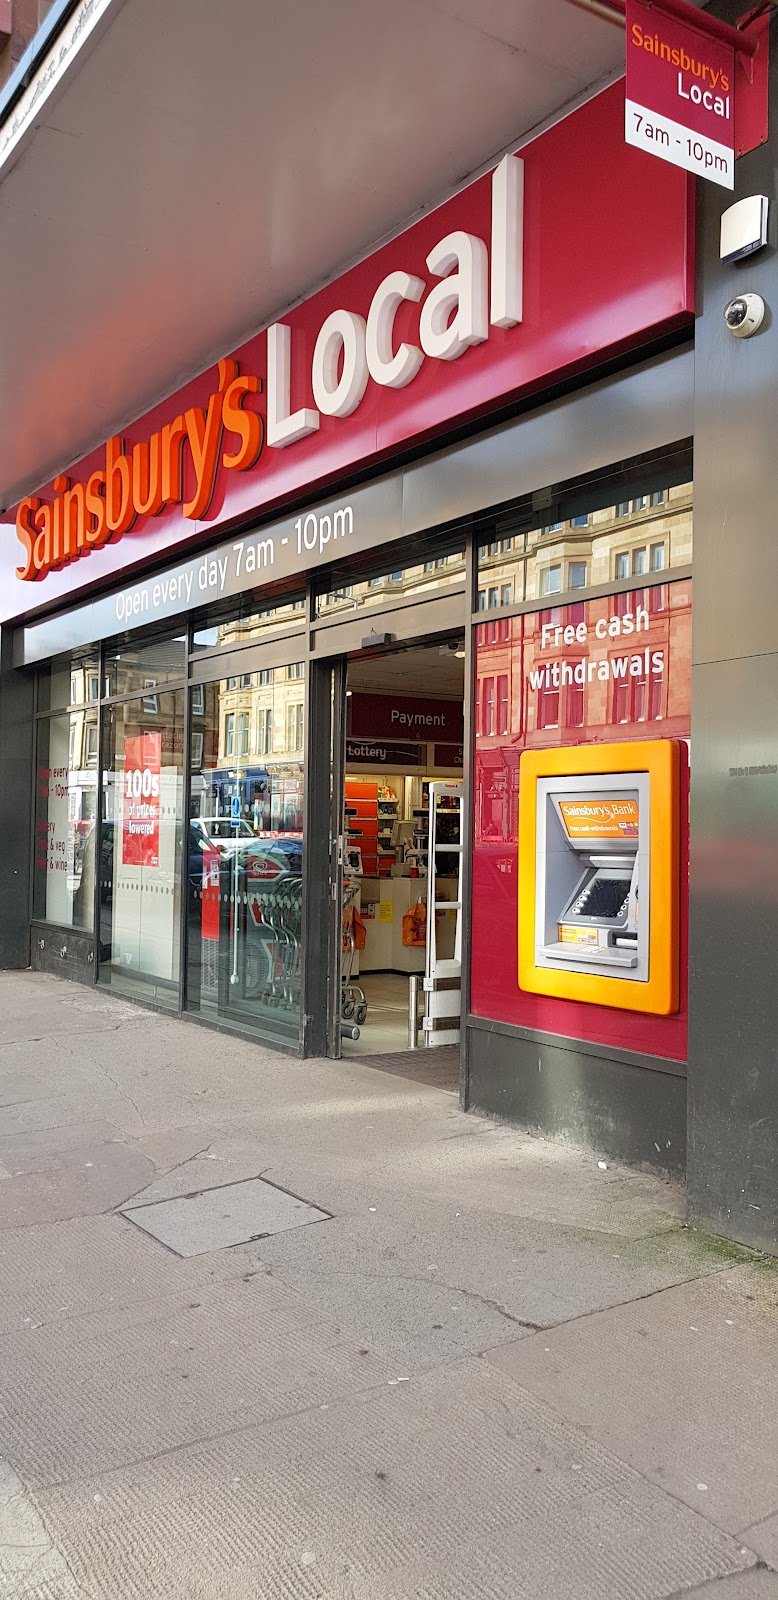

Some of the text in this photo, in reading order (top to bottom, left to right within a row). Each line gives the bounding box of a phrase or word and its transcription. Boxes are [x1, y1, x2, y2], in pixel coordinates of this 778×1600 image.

[631, 23, 730, 92] Sainsbury's
[677, 71, 730, 119] Local
[633, 112, 670, 147] 7am
[686, 138, 728, 174] 10pm
[15, 153, 524, 581] Sainsbury's Local
[115, 586, 149, 625] Open
[152, 568, 194, 603] every
[198, 554, 229, 591] day
[233, 536, 275, 577] 7am
[294, 506, 354, 554] 10pm
[540, 604, 650, 649] Free cash
[529, 646, 665, 690] withdrawals
[391, 709, 446, 727] Payment
[348, 744, 387, 760] Lottery
[125, 768, 159, 798] 100s
[128, 801, 157, 819] of prices
[128, 820, 155, 835] lowered
[563, 803, 637, 817] Sainsbury's Bank
[55, 857, 68, 872] wine
